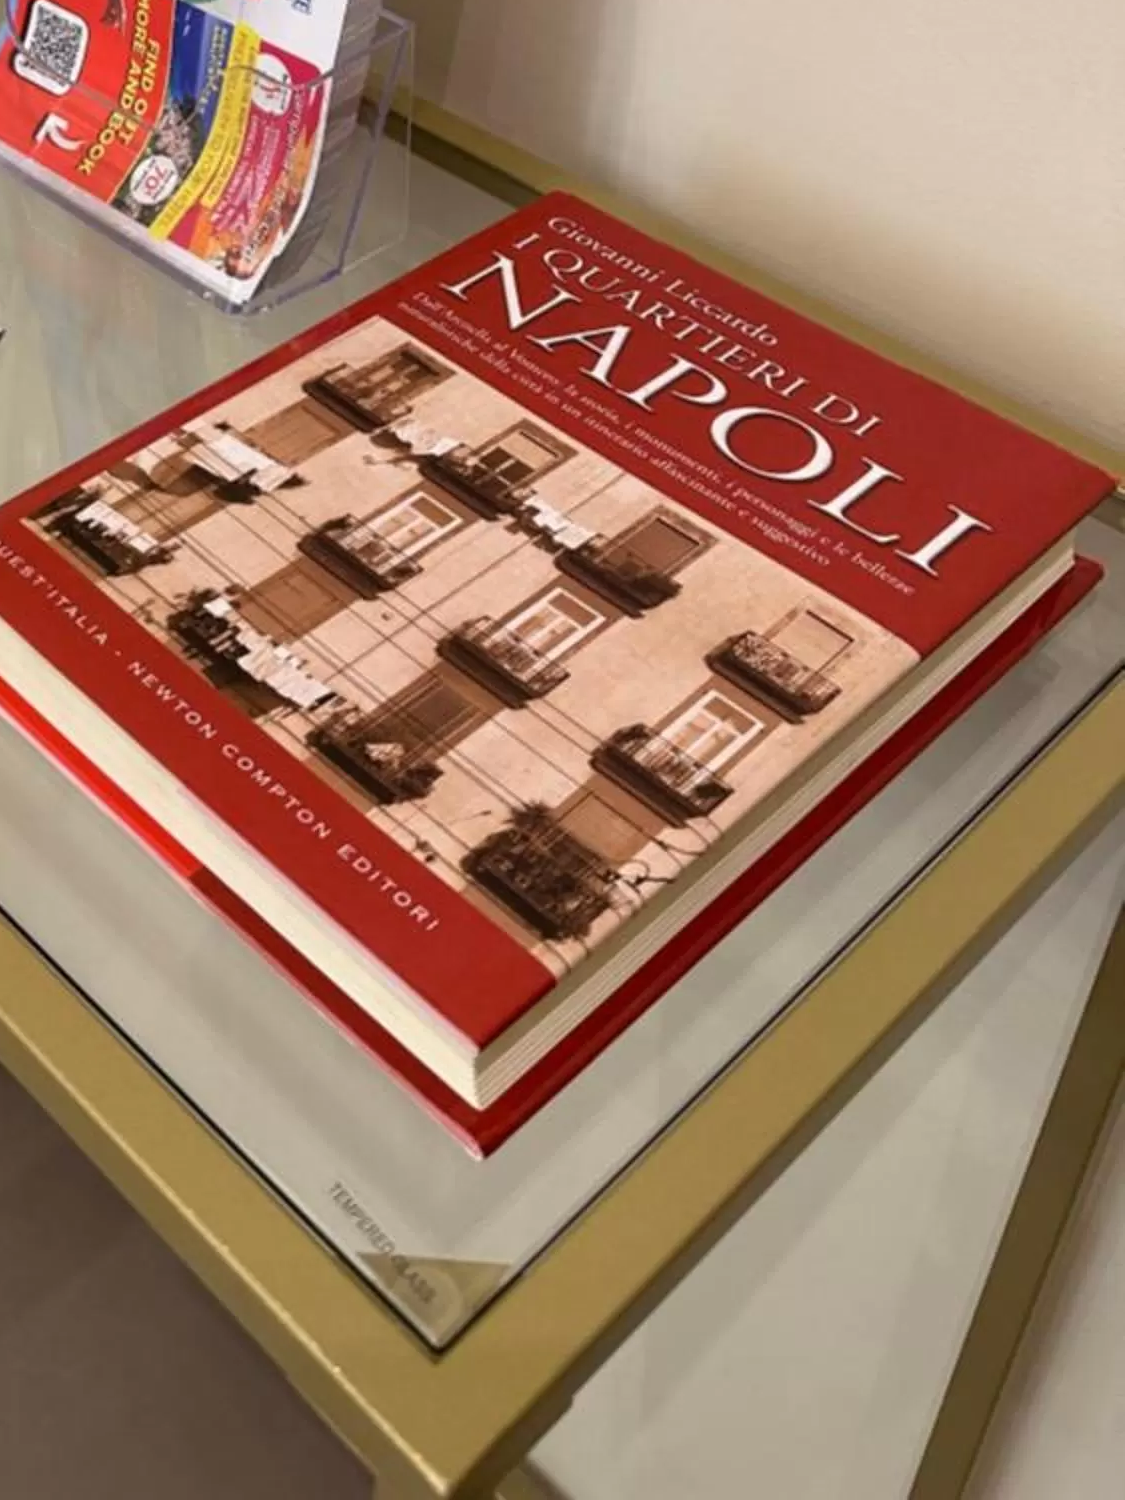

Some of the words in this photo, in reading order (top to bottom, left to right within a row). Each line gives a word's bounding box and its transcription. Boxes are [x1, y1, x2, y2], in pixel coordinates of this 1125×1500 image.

[121, 58, 142, 110] AND
[141, 37, 161, 94] FIND
[78, 110, 125, 177] BOOK
[547, 214, 666, 286] Giovanni
[664, 268, 780, 348] Liccardo
[511, 231, 541, 252] I
[540, 245, 809, 401] QUARTIERI
[810, 391, 883, 439] DI
[440, 250, 995, 579] NAPOLI
[731, 485, 820, 539] personaggi
[750, 515, 831, 566] suggestivo
[127, 659, 217, 741] NEWTON
[221, 740, 333, 841] COMPTON
[336, 842, 442, 933] EDITORI
